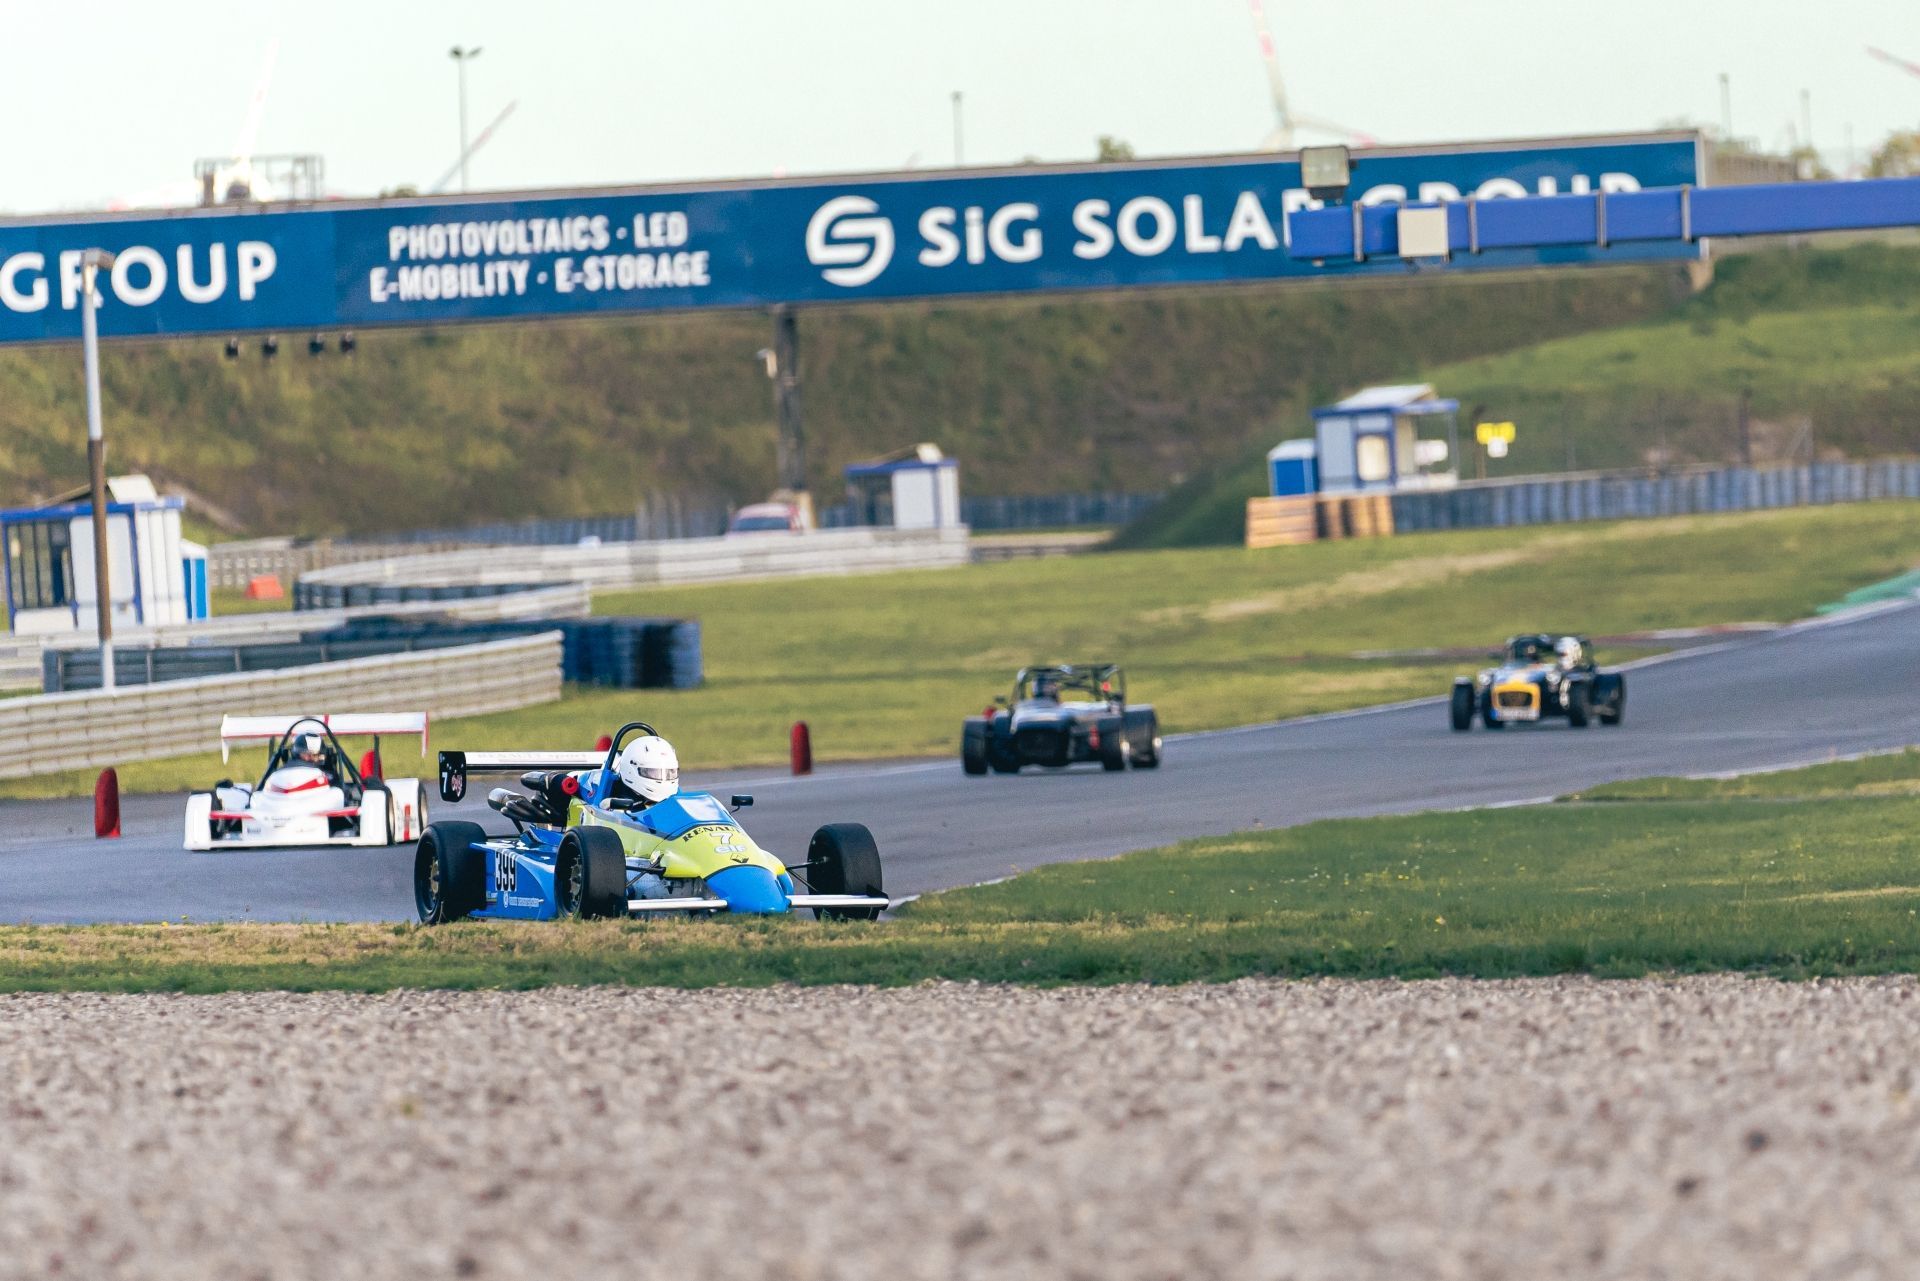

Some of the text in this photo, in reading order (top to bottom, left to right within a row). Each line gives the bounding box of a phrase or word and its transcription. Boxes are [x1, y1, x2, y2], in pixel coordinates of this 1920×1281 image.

[388, 211, 689, 262] PHOTOVOLTAICS LED
[0, 240, 278, 314] GROUP
[369, 250, 712, 303] E-MOBILITY E-STORAGE
[441, 771, 449, 793] 7
[710, 831, 734, 845] 7
[495, 849, 517, 892] 399
